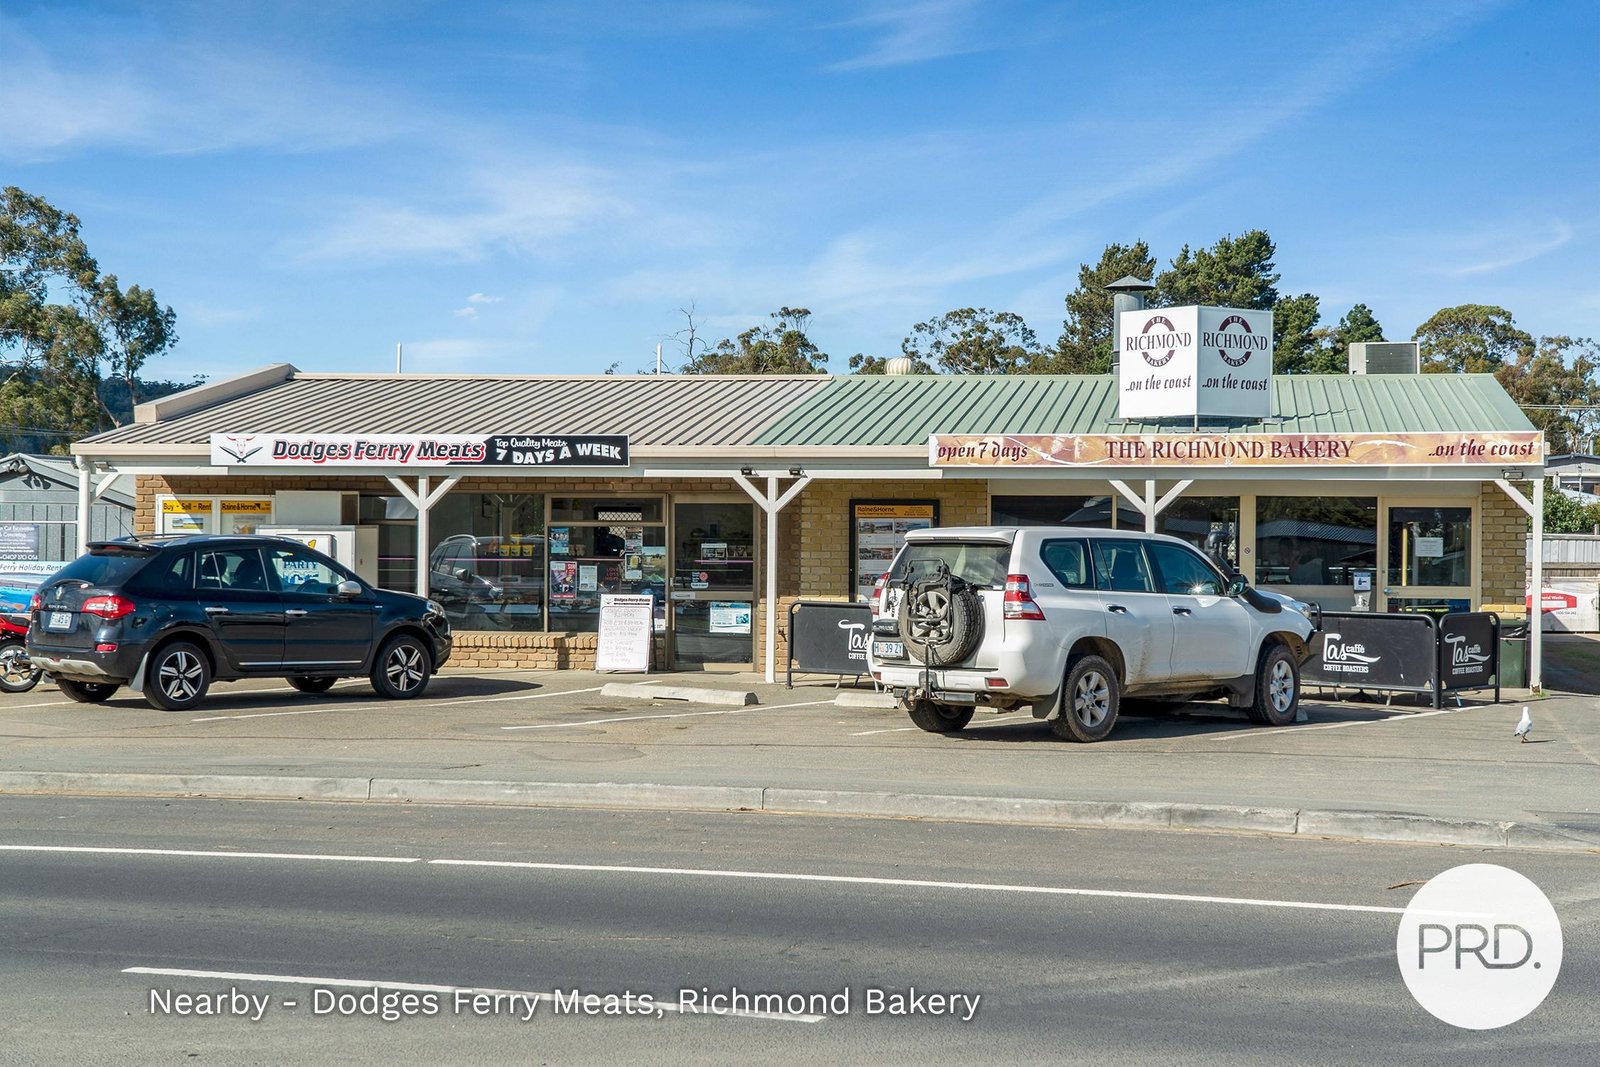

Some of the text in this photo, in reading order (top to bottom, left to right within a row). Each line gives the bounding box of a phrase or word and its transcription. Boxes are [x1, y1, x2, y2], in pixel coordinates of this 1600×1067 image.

[1151, 316, 1166, 324] THE
[1228, 316, 1243, 324] THE
[1126, 332, 1192, 351] RICHMOND
[1203, 332, 1268, 351] RICHMOND
[1146, 355, 1171, 367] BAKERY
[1223, 355, 1248, 367] BAKERY
[1145, 374, 1161, 390] the
[1164, 375, 1191, 389] coast
[1222, 373, 1238, 389] the
[1240, 377, 1267, 391] coast
[494, 437, 567, 449] Top Quality Meats
[1105, 440, 1354, 458] THE RICHMOND BAKERY
[1460, 438, 1485, 456] the
[1490, 441, 1534, 456] coast
[272, 439, 485, 463] Dodges Ferry Meats
[496, 443, 621, 464] 7 DAYS A WEEK
[937, 441, 1029, 462] open 7 days
[163, 502, 174, 511] Buy
[181, 502, 192, 510] Sell
[198, 502, 212, 510] Rent
[221, 502, 257, 511] Raine&Horne
[18, 563, 45, 572] Holiday
[284, 561, 318, 569] PARTY
[1444, 633, 1469, 666] Tas
[1323, 663, 1369, 673] COFFEE ROASTERS
